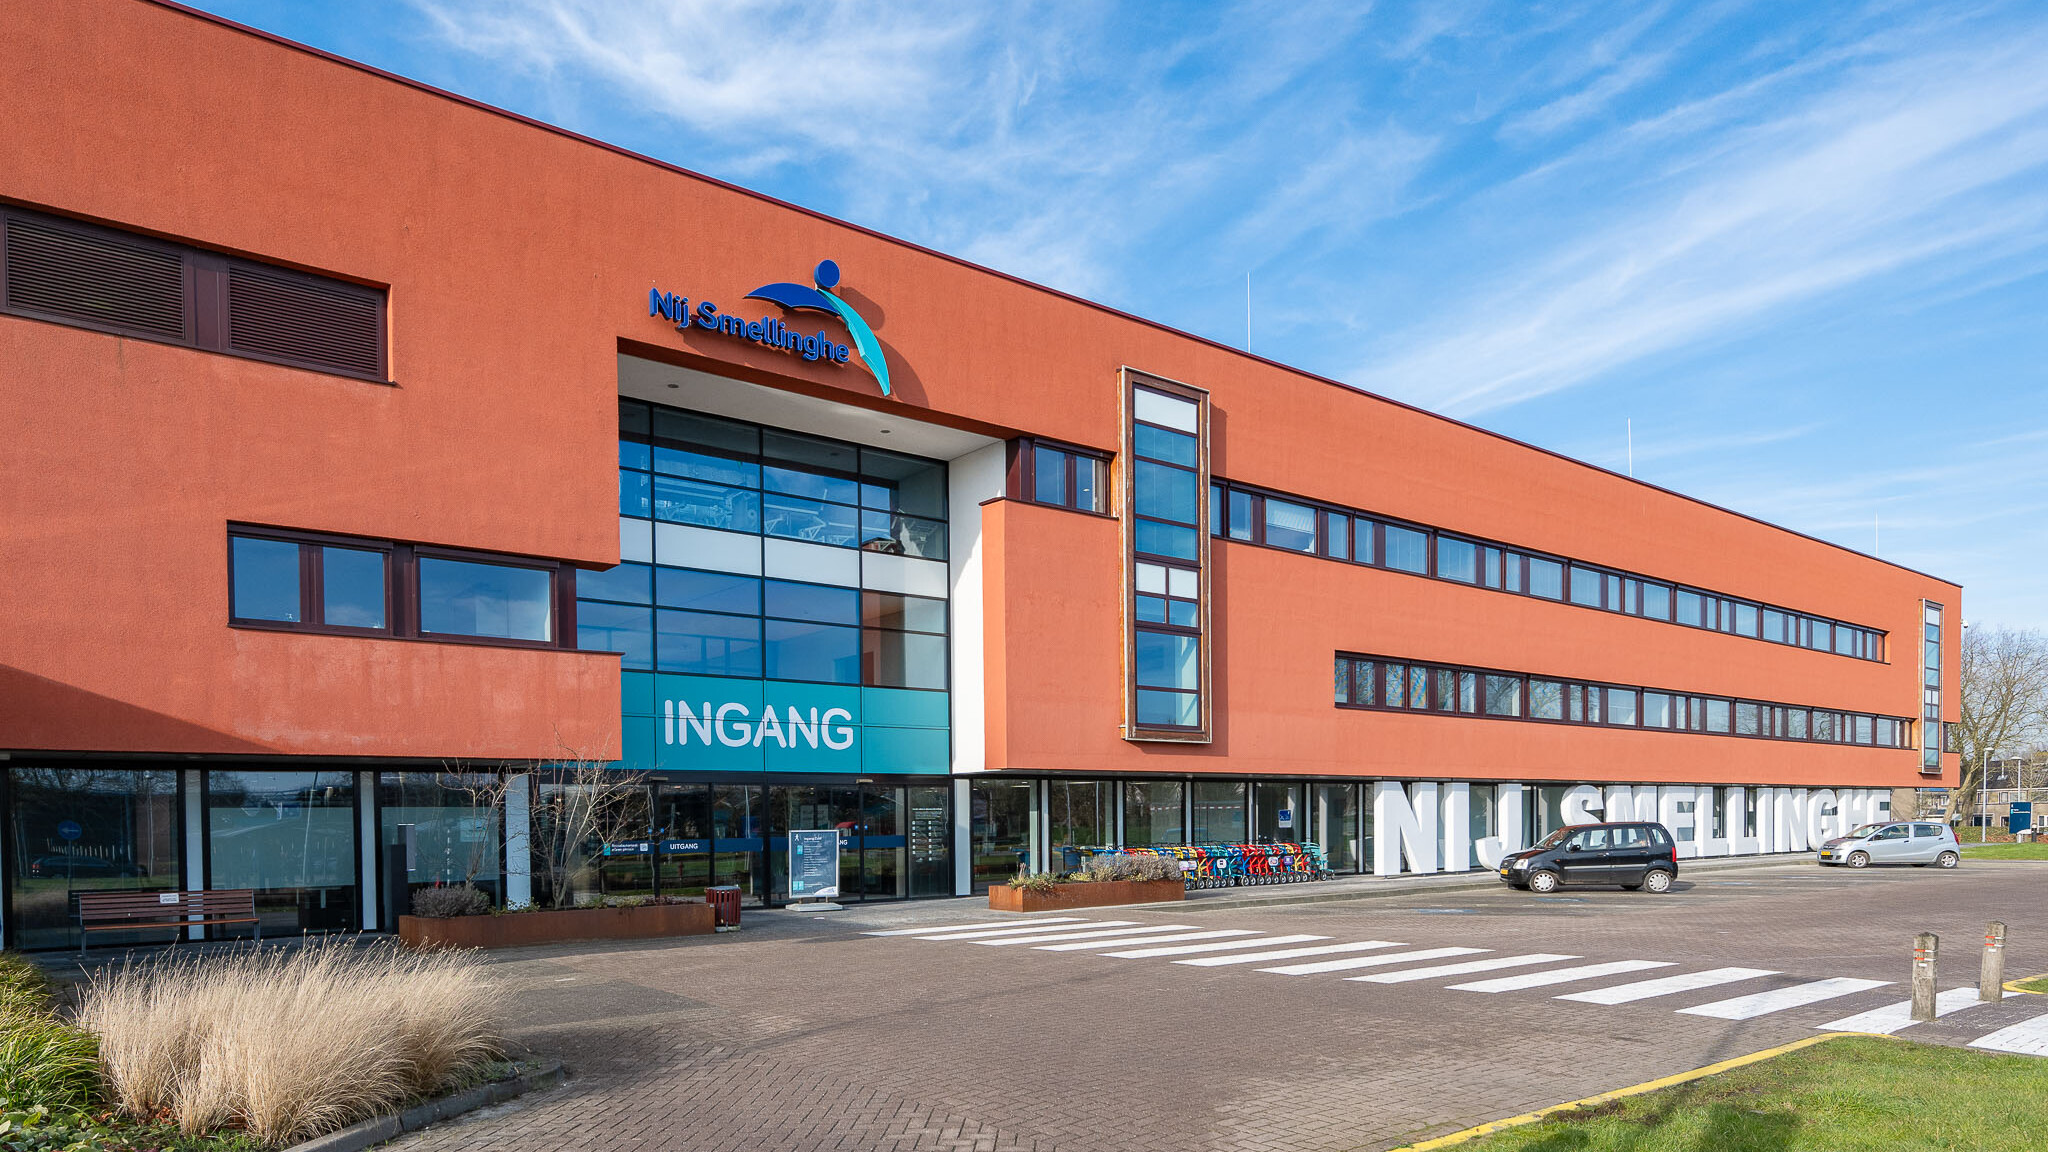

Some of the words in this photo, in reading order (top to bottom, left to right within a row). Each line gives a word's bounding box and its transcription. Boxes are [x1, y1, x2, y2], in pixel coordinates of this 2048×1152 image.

[649, 287, 690, 329] Nij
[698, 301, 850, 363] Smellinghe
[664, 699, 854, 750] INGANG
[669, 842, 699, 850] UITGANG
[1373, 781, 1523, 877] NIJ
